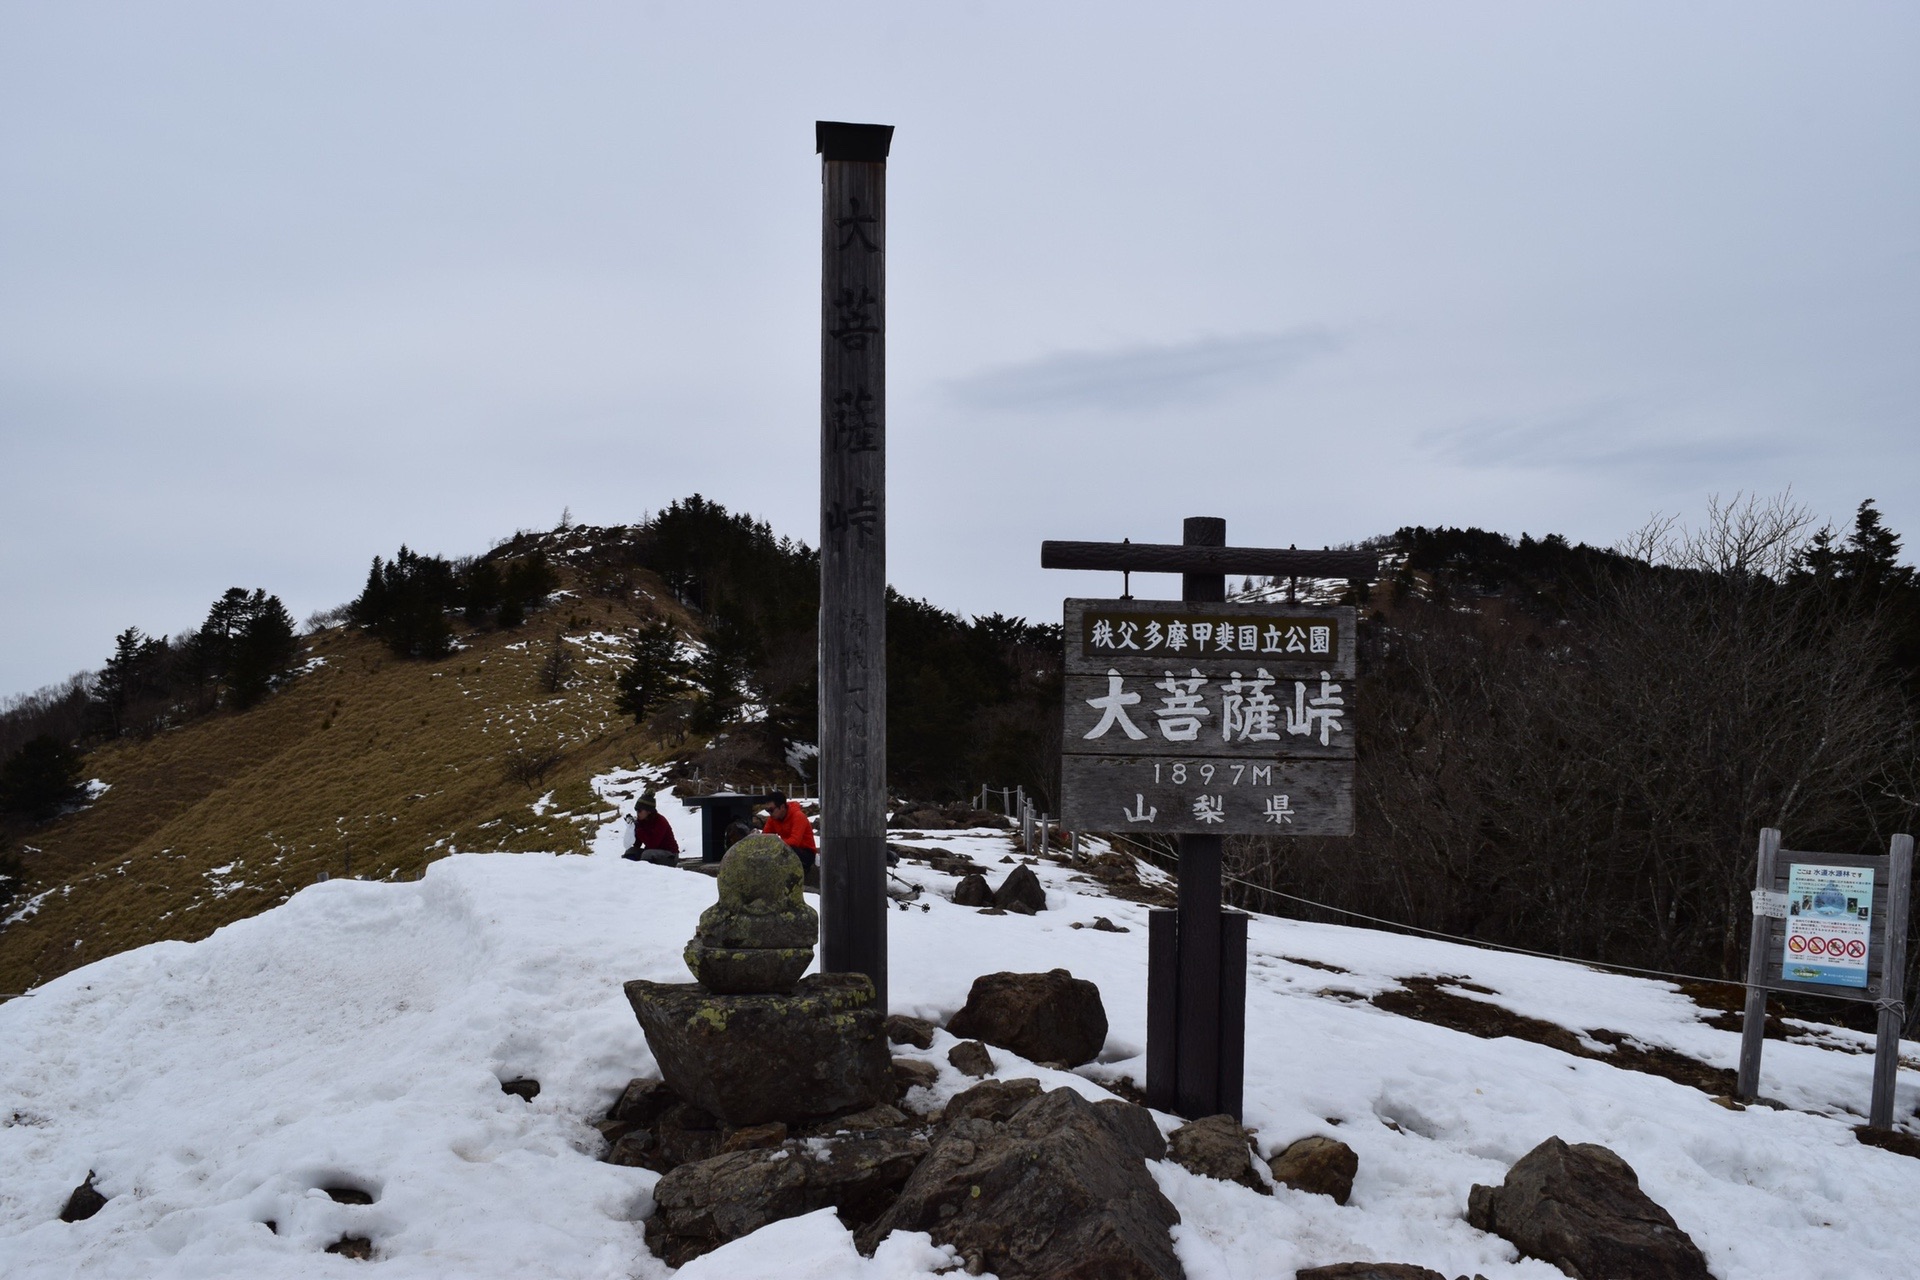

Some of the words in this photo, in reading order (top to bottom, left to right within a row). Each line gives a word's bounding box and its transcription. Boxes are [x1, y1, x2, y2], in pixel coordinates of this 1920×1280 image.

[826, 197, 881, 548] 大菩薩峠
[1090, 619, 1330, 654] 秩父多摩甲斐国立公園
[1083, 667, 1344, 746] 大菩薩峠
[1154, 763, 1273, 786] 1897M
[1123, 793, 1295, 824] 山梨県
